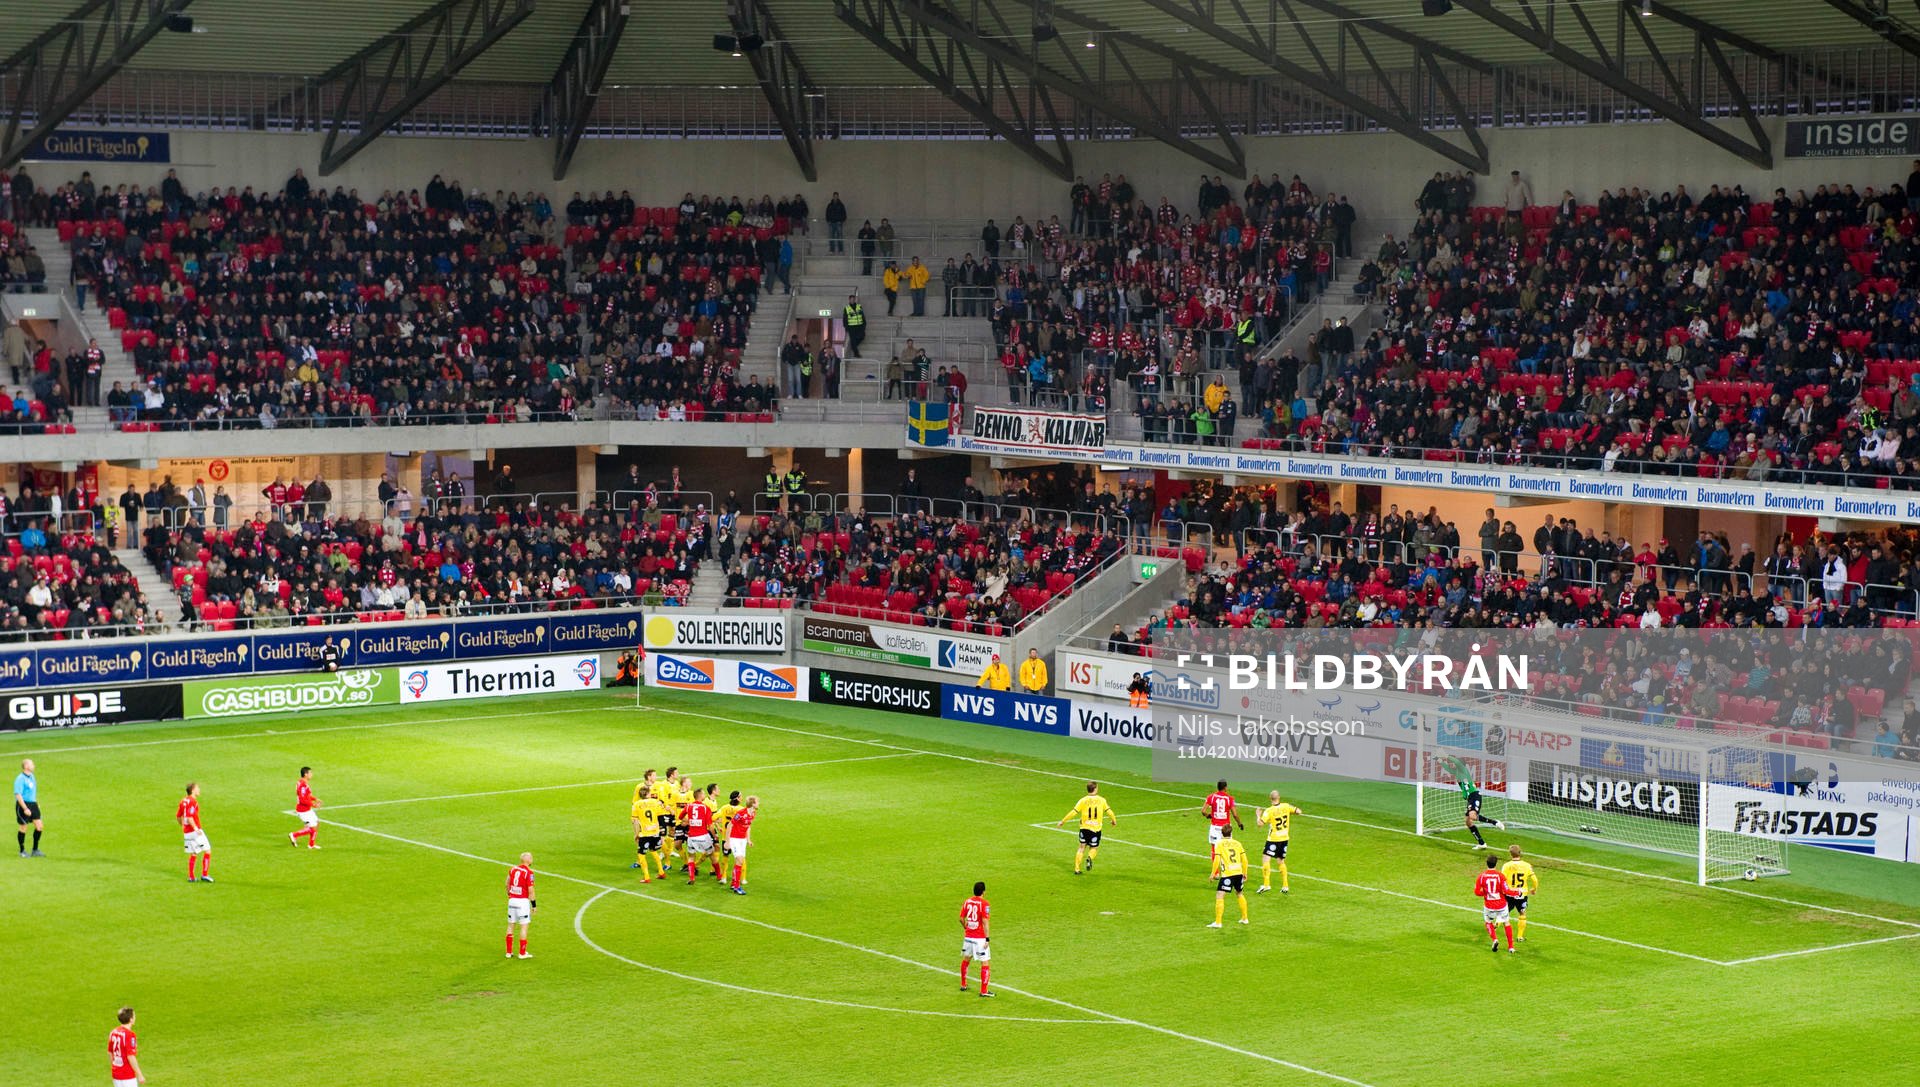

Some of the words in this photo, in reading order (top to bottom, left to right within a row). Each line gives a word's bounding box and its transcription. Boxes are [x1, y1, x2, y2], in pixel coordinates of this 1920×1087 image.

[1805, 119, 1909, 145] inside
[44, 136, 84, 154] Guld
[87, 136, 137, 159] Fågeln
[1805, 149, 1839, 157] QUALITY
[1842, 148, 1866, 157] MENS
[1868, 146, 1907, 156] CLOTHES
[974, 412, 1022, 442] BENNO
[1044, 417, 1105, 448] KALMAR
[1139, 449, 1181, 465] Barometern
[1187, 452, 1230, 468] Barometern
[1236, 456, 1281, 472] Barometern
[1288, 459, 1333, 476] Barometern
[1340, 463, 1387, 480] Barometern
[1394, 467, 1443, 483] Barometern
[1451, 471, 1501, 488] Barometern
[1509, 475, 1561, 492] Barometern
[1569, 479, 1623, 497] Barometern
[1632, 483, 1688, 501] Barometern
[1697, 487, 1755, 506] Barometern
[1764, 492, 1824, 511] Barometern
[1834, 497, 1897, 516] Barometern
[459, 630, 492, 648] Guld
[494, 629, 536, 648] Fågeln
[554, 624, 586, 642] Guld
[588, 622, 628, 642] Fågeln
[677, 620, 783, 646] SOLENERGIHUS
[806, 623, 866, 643] scanomat
[258, 643, 294, 661] Guld
[295, 641, 320, 661] Fåg
[360, 636, 395, 654] Guld
[397, 635, 440, 655] Fågeln
[958, 642, 993, 656] KALMAR
[41, 656, 79, 675] Guld
[82, 653, 130, 675] Fågeln
[152, 649, 188, 668] Guld
[191, 647, 237, 669] Fågeln
[958, 653, 982, 666] HAMN
[447, 663, 556, 694] Thermia
[659, 660, 708, 684] elspar
[741, 667, 791, 691] elspar
[1070, 661, 1103, 687] KST
[207, 684, 369, 712] CASHBUDDY.se
[834, 680, 931, 710] EKEFORSHUS
[953, 692, 995, 717] NVS
[38, 716, 53, 727] The
[53, 715, 72, 727] right
[72, 715, 98, 726] gloves
[1014, 701, 1058, 726] NVS
[1078, 708, 1173, 744] Volvokort
[1508, 727, 1573, 751] HARP
[1552, 765, 1681, 815] Inspecta
[1817, 789, 1846, 804] BONG
[1867, 790, 1914, 810] packaging
[644, 810, 653, 822] 9
[692, 804, 699, 820] 5
[1088, 806, 1098, 820] 11
[1733, 801, 1878, 838] FRISTADS
[1275, 815, 1288, 831] 22
[1511, 873, 1525, 888] 15
[966, 904, 979, 921] 28
